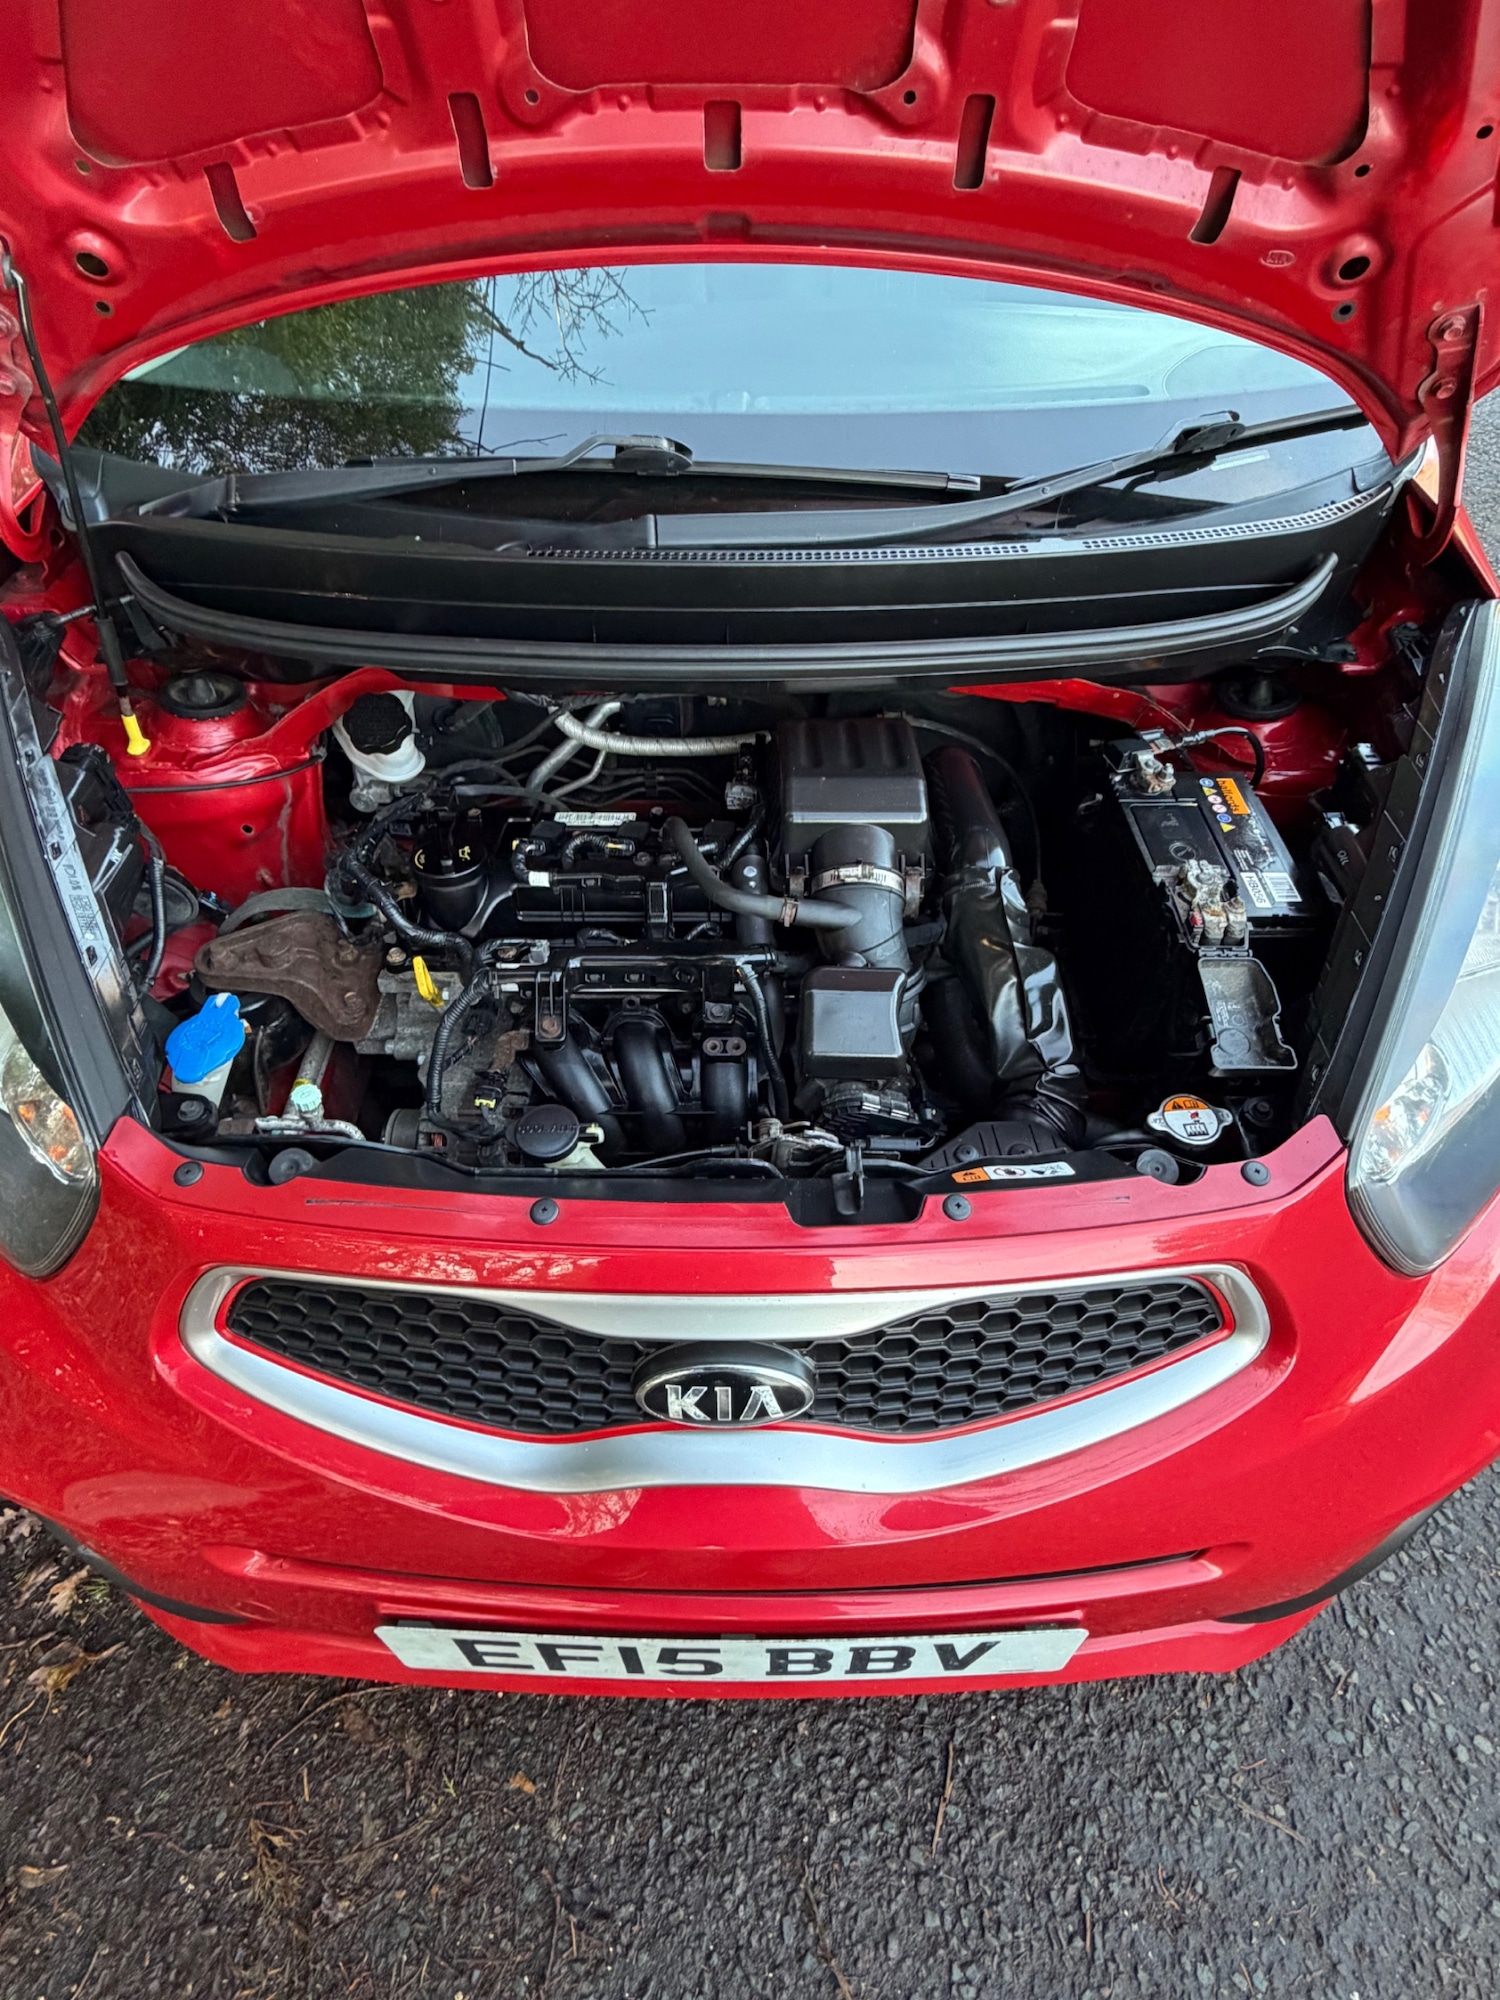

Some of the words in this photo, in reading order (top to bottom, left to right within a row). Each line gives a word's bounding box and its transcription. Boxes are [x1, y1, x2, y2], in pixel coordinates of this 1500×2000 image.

[1217, 779, 1240, 813] halfords
[1244, 875, 1267, 904] HB056
[665, 1384, 784, 1421] KIA
[452, 1638, 723, 1675] EF15
[765, 1641, 1001, 1675] BBV
